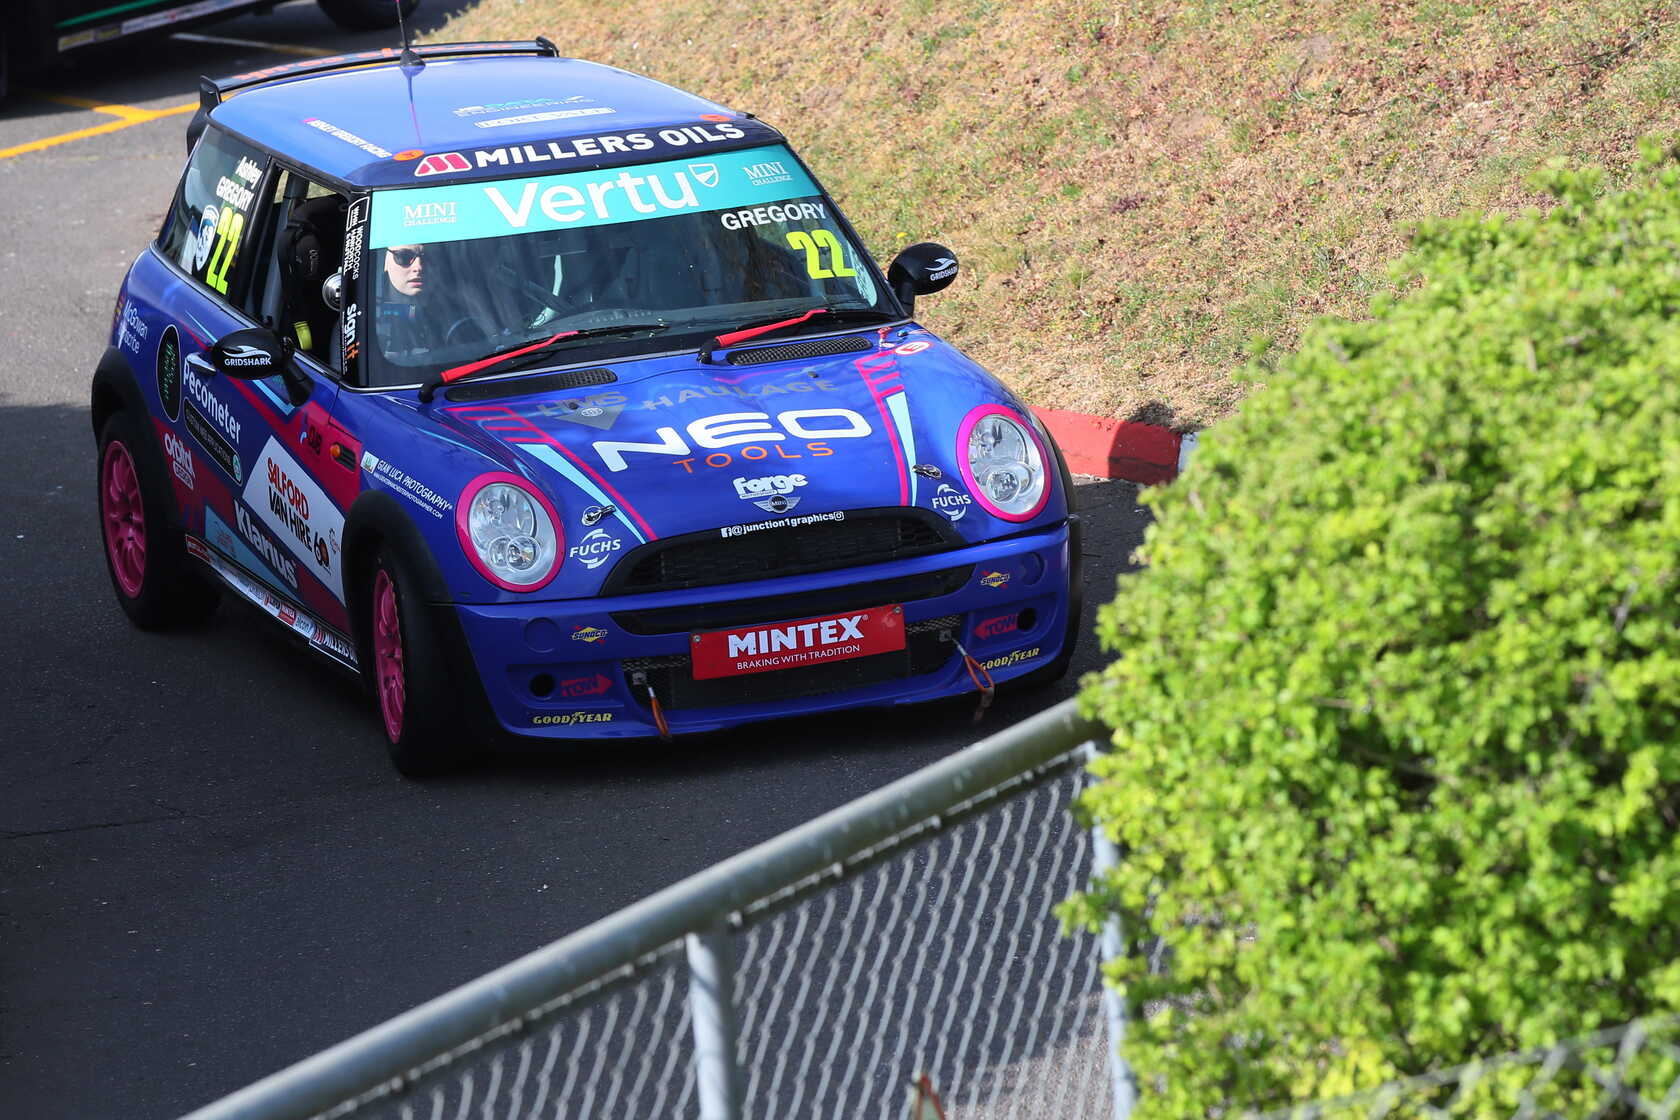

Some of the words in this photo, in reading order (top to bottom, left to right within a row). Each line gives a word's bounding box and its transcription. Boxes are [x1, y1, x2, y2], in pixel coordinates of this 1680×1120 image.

[475, 133, 656, 169] MILLERS
[658, 122, 746, 147] OILS
[234, 155, 263, 190] Ashley
[743, 161, 789, 180] MINI
[752, 174, 793, 186] CHALLENGE
[215, 175, 255, 212] GREGORY
[403, 201, 457, 219] MINI
[484, 170, 700, 228] Vertu
[720, 202, 828, 231] GREGORY
[206, 206, 244, 295] 22
[353, 226, 364, 280] WOODCOCKS
[785, 229, 857, 280] 22
[224, 357, 272, 367] GRIDSHARK
[184, 358, 241, 445] Pecometer
[641, 379, 839, 412] HAULAGE
[592, 407, 873, 473] NEO
[377, 459, 393, 475] GIAN
[388, 466, 405, 483] LUCA
[671, 441, 834, 475] TOOLS
[267, 456, 310, 521] SALFORD
[733, 474, 808, 496] Forge
[932, 494, 972, 509] FUCHS
[268, 485, 290, 529] VAN
[288, 507, 313, 553] HIRE
[731, 511, 835, 537] @junction1graphics
[233, 499, 298, 590] Klarius
[569, 538, 622, 558] FUCHS
[727, 615, 865, 659] MINTEX
[736, 656, 780, 670] BRAKING
[781, 653, 808, 664] WITH
[808, 644, 861, 660] TRADITION
[980, 647, 1041, 671] GOODYEAR
[532, 711, 613, 726] GOODYEAR
